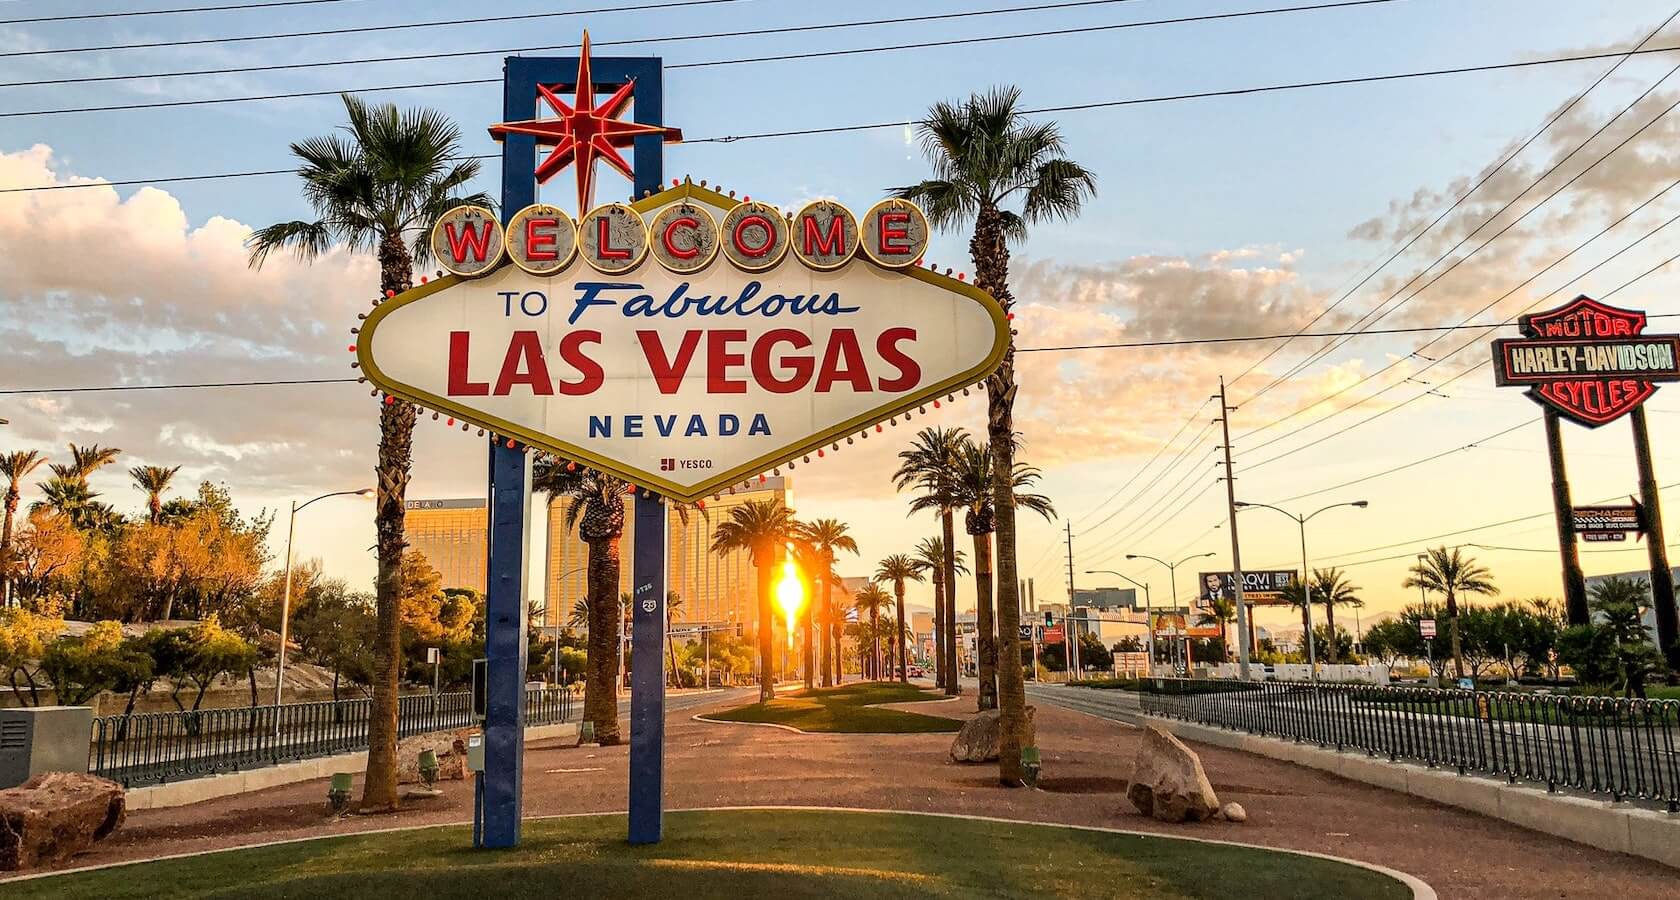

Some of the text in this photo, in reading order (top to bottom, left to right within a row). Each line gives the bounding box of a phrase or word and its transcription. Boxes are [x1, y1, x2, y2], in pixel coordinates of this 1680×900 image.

[444, 211, 912, 264] WELCOME
[497, 281, 860, 325] TO Fabulous
[1546, 307, 1632, 337] MOTOR
[447, 327, 922, 397] LAS VEGAS
[1511, 343, 1675, 374] HARLEY-DAVIDSON
[1553, 380, 1639, 415] CYCLES
[588, 413, 773, 438] NEVADA
[679, 458, 712, 469] YESCO
